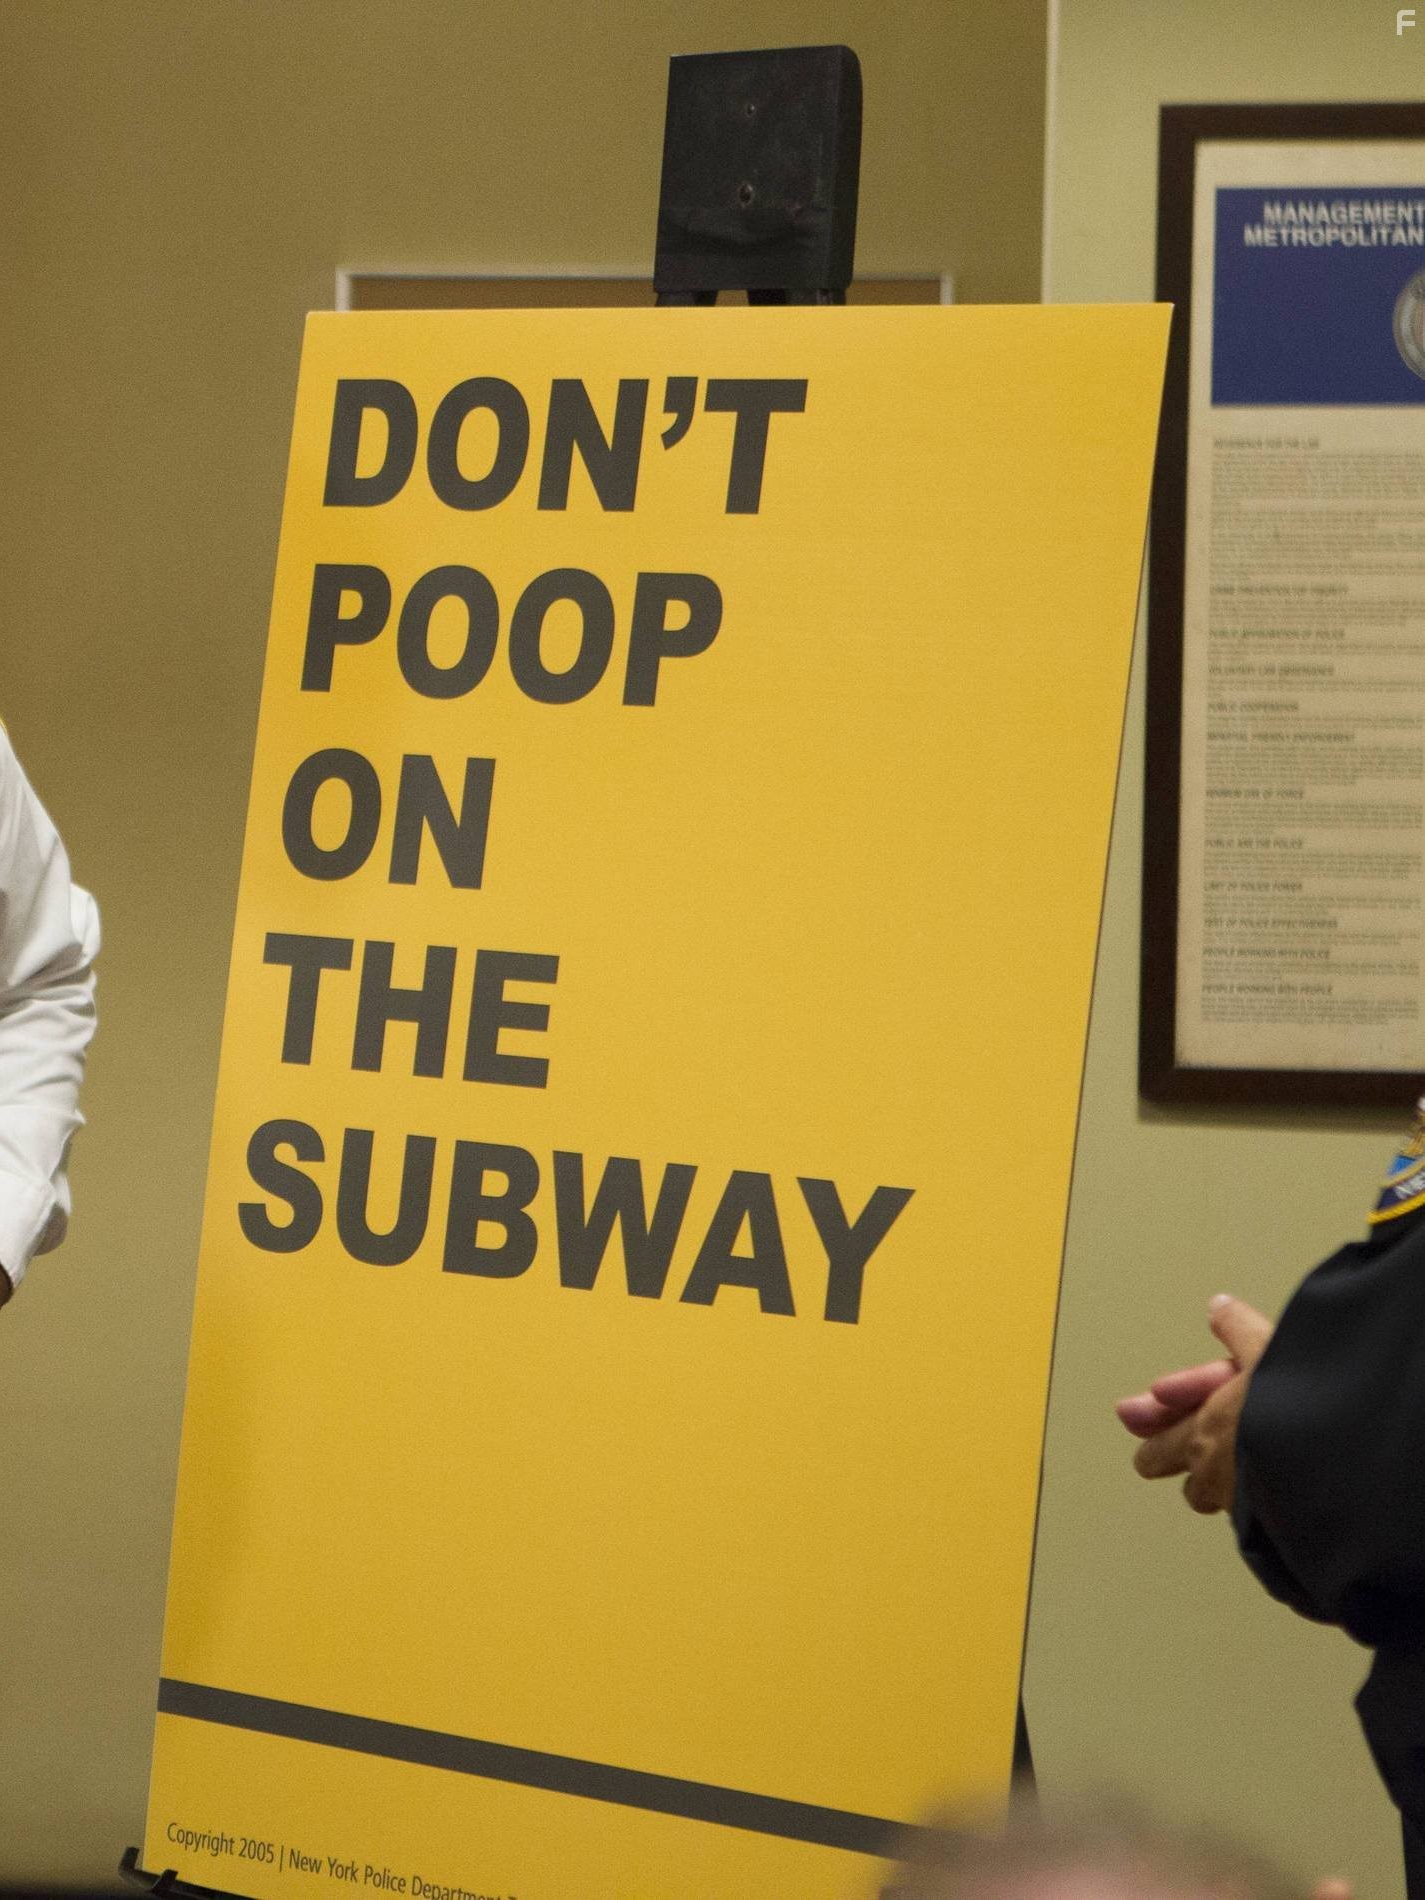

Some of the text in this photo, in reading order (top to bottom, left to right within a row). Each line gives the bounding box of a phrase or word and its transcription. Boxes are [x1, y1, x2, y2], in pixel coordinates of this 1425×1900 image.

[1243, 224, 1424, 248] METROPOLITAN
[1262, 201, 1425, 225] MANAGEMENT
[323, 376, 809, 515] DON'T
[300, 562, 724, 707] POOP
[281, 747, 497, 890] ON
[262, 931, 560, 1090] THE
[237, 1118, 916, 1325] SUBWAY
[167, 1822, 235, 1857] Copyright
[238, 1838, 274, 1864] 2005
[289, 1848, 322, 1875] New
[327, 1856, 359, 1883] York
[364, 1864, 407, 1894] Police
